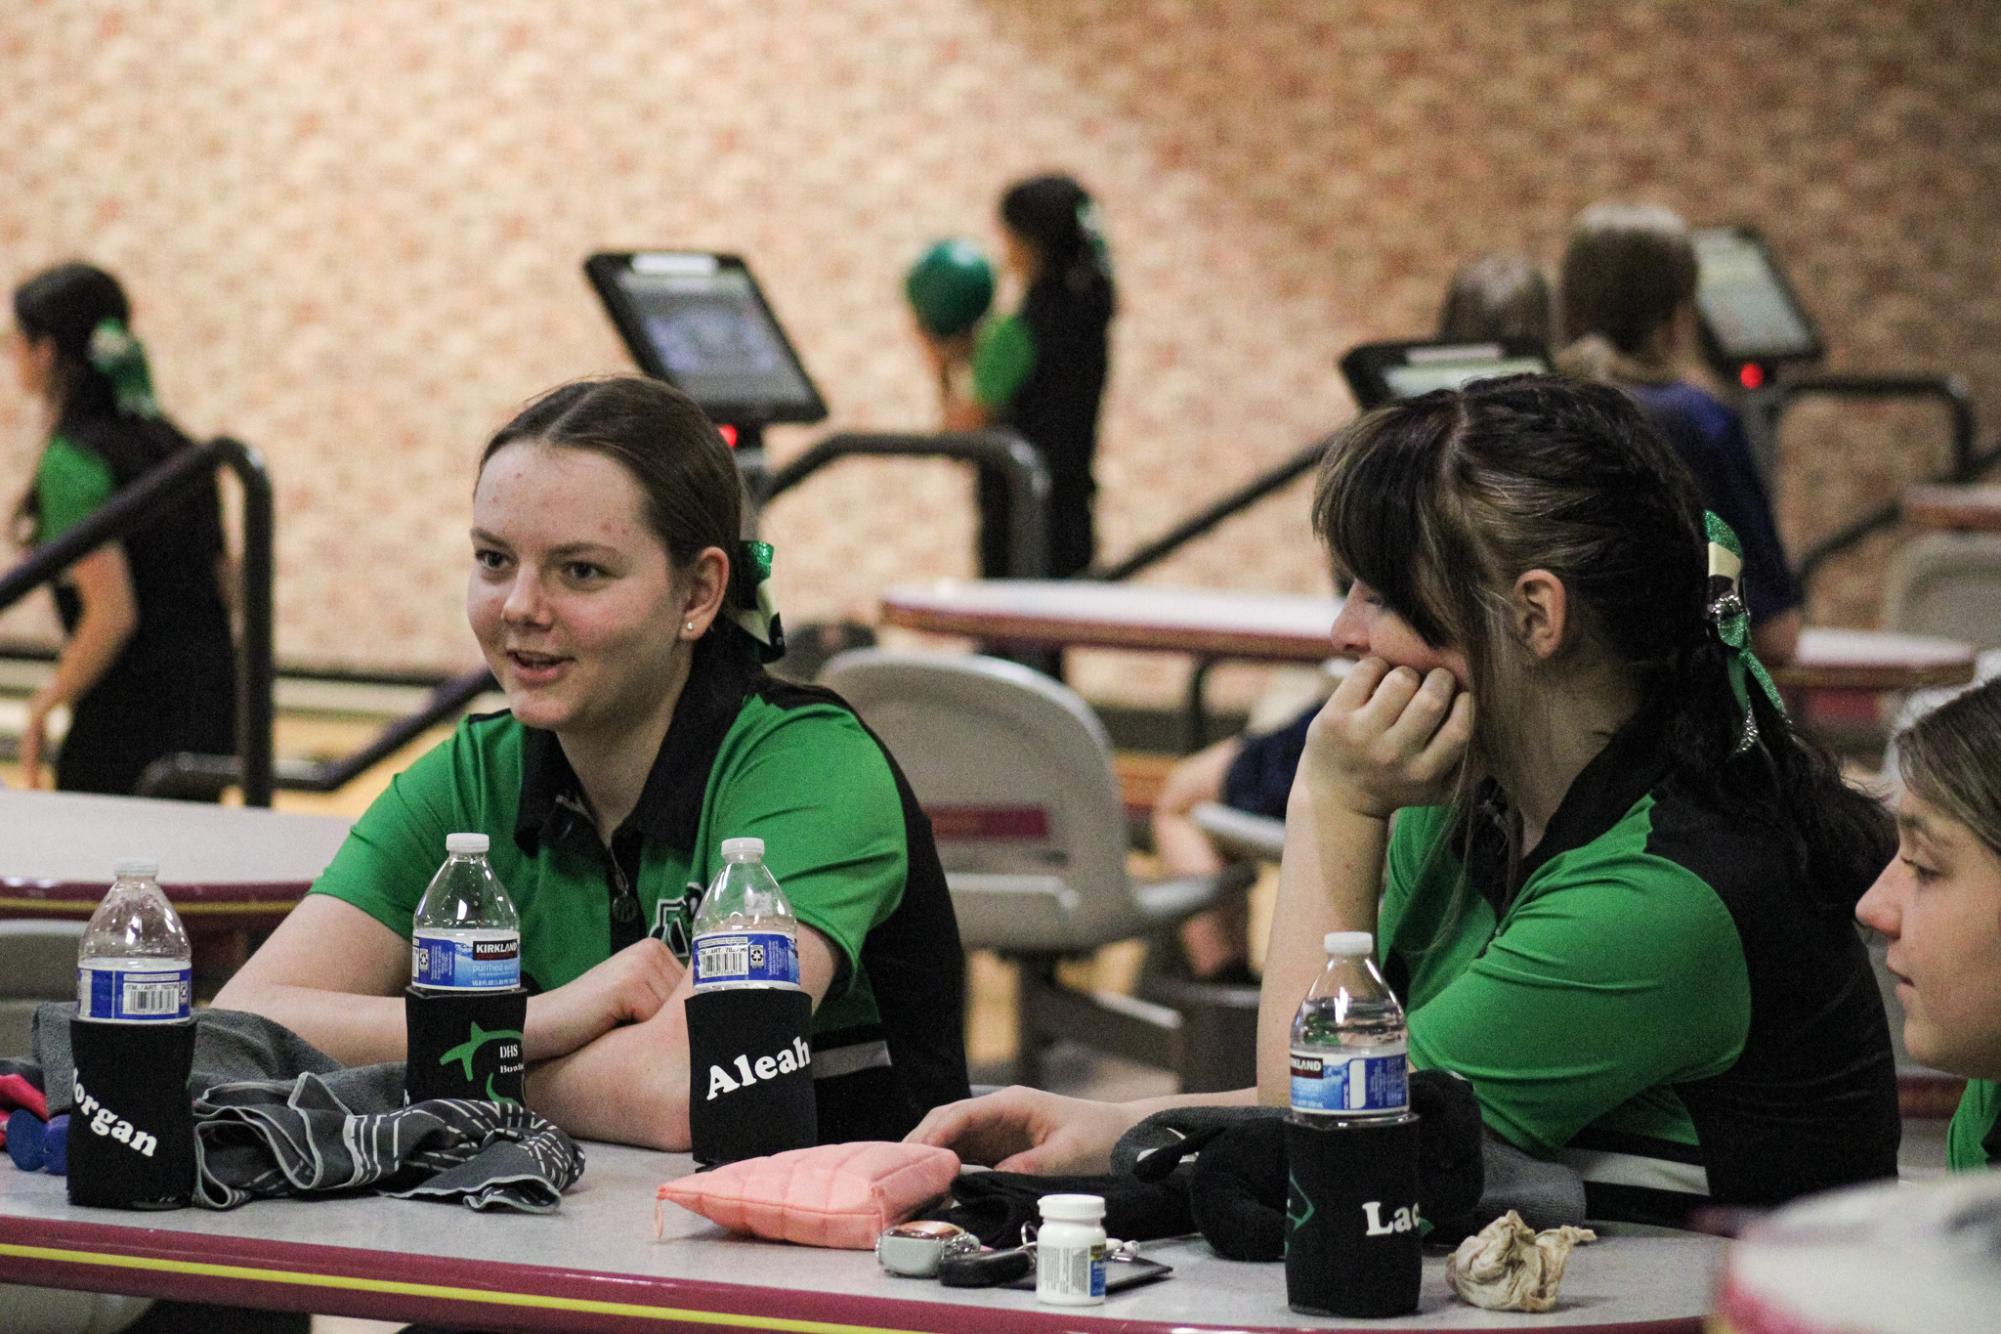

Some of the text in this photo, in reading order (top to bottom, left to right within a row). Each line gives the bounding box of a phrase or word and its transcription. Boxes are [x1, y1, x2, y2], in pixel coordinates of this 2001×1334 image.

[475, 942, 518, 954] KIRKLAND
[499, 1044, 518, 1059] DHS
[706, 1036, 811, 1100] Aleah
[73, 1067, 158, 1157] organ
